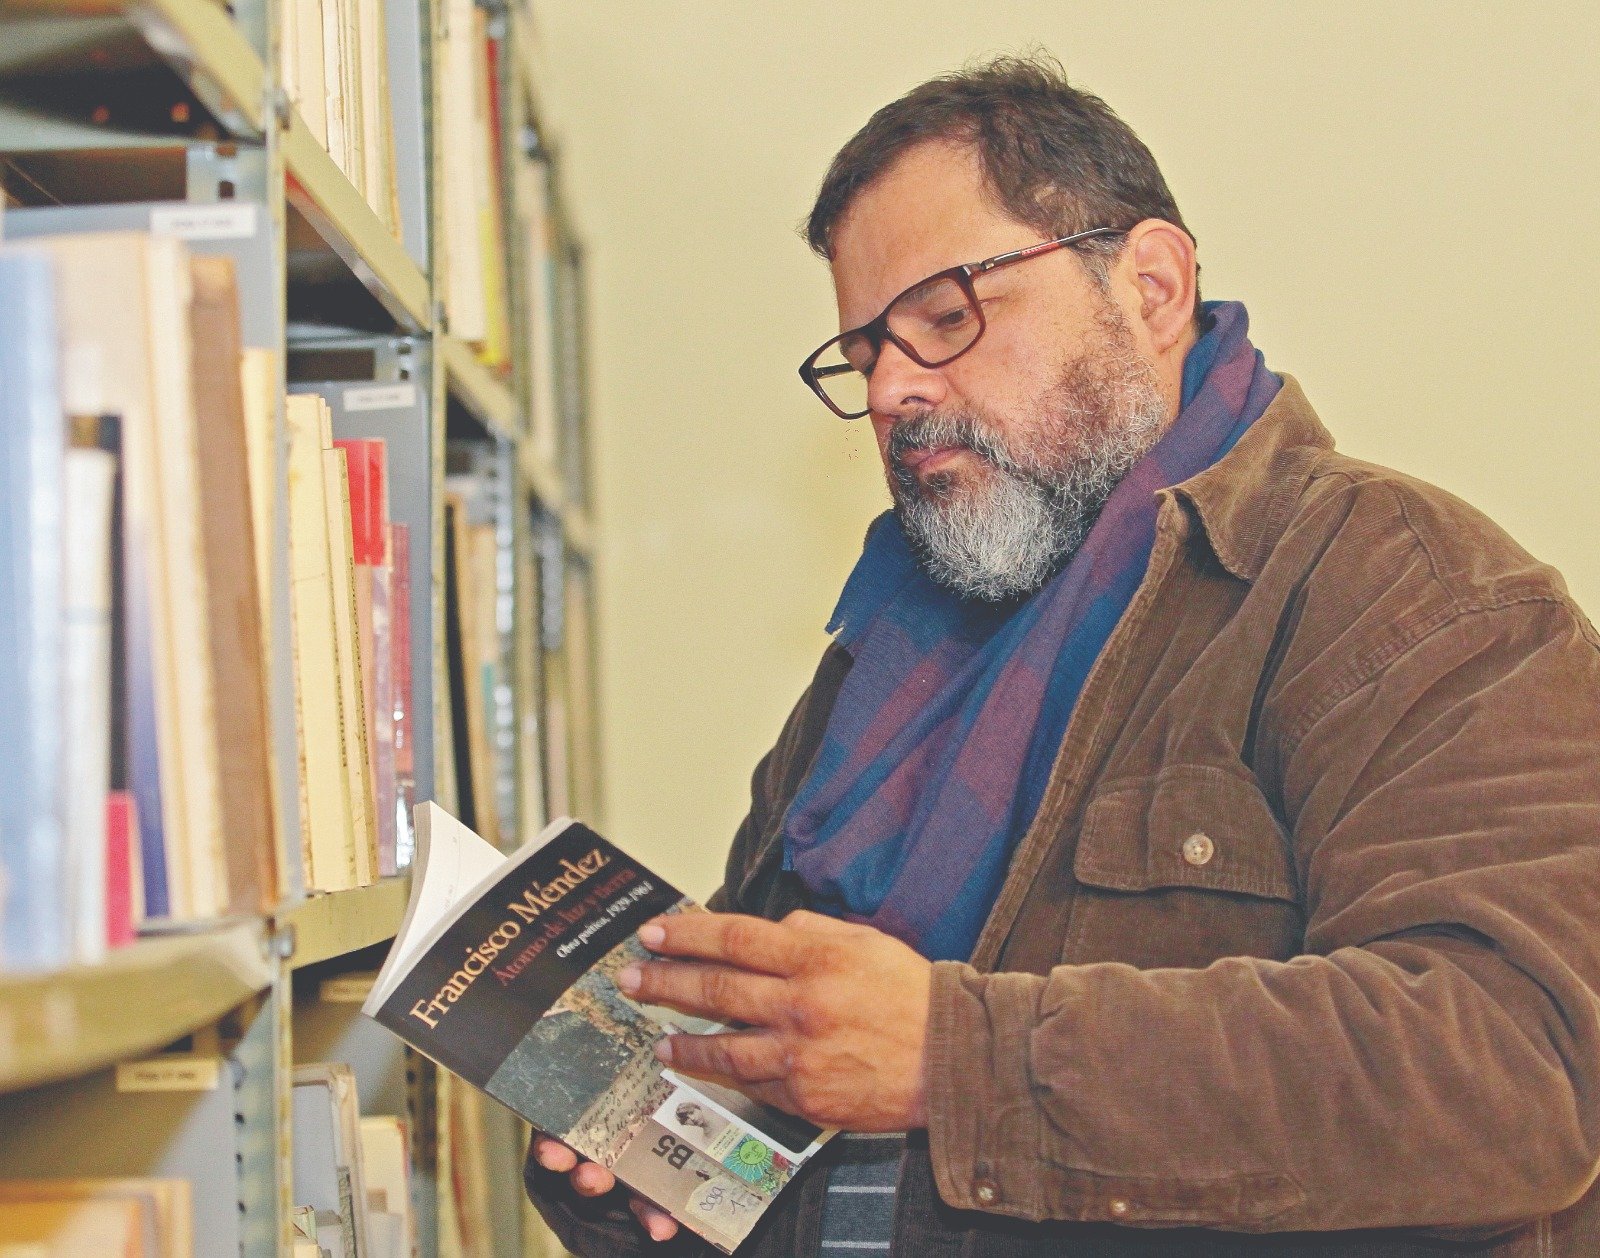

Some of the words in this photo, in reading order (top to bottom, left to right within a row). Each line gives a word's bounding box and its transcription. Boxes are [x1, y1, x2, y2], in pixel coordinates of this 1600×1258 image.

[409, 920, 521, 1029] Francisco
[506, 848, 611, 924] Méndez
[556, 938, 580, 958] Obra
[651, 1134, 695, 1170] B5
